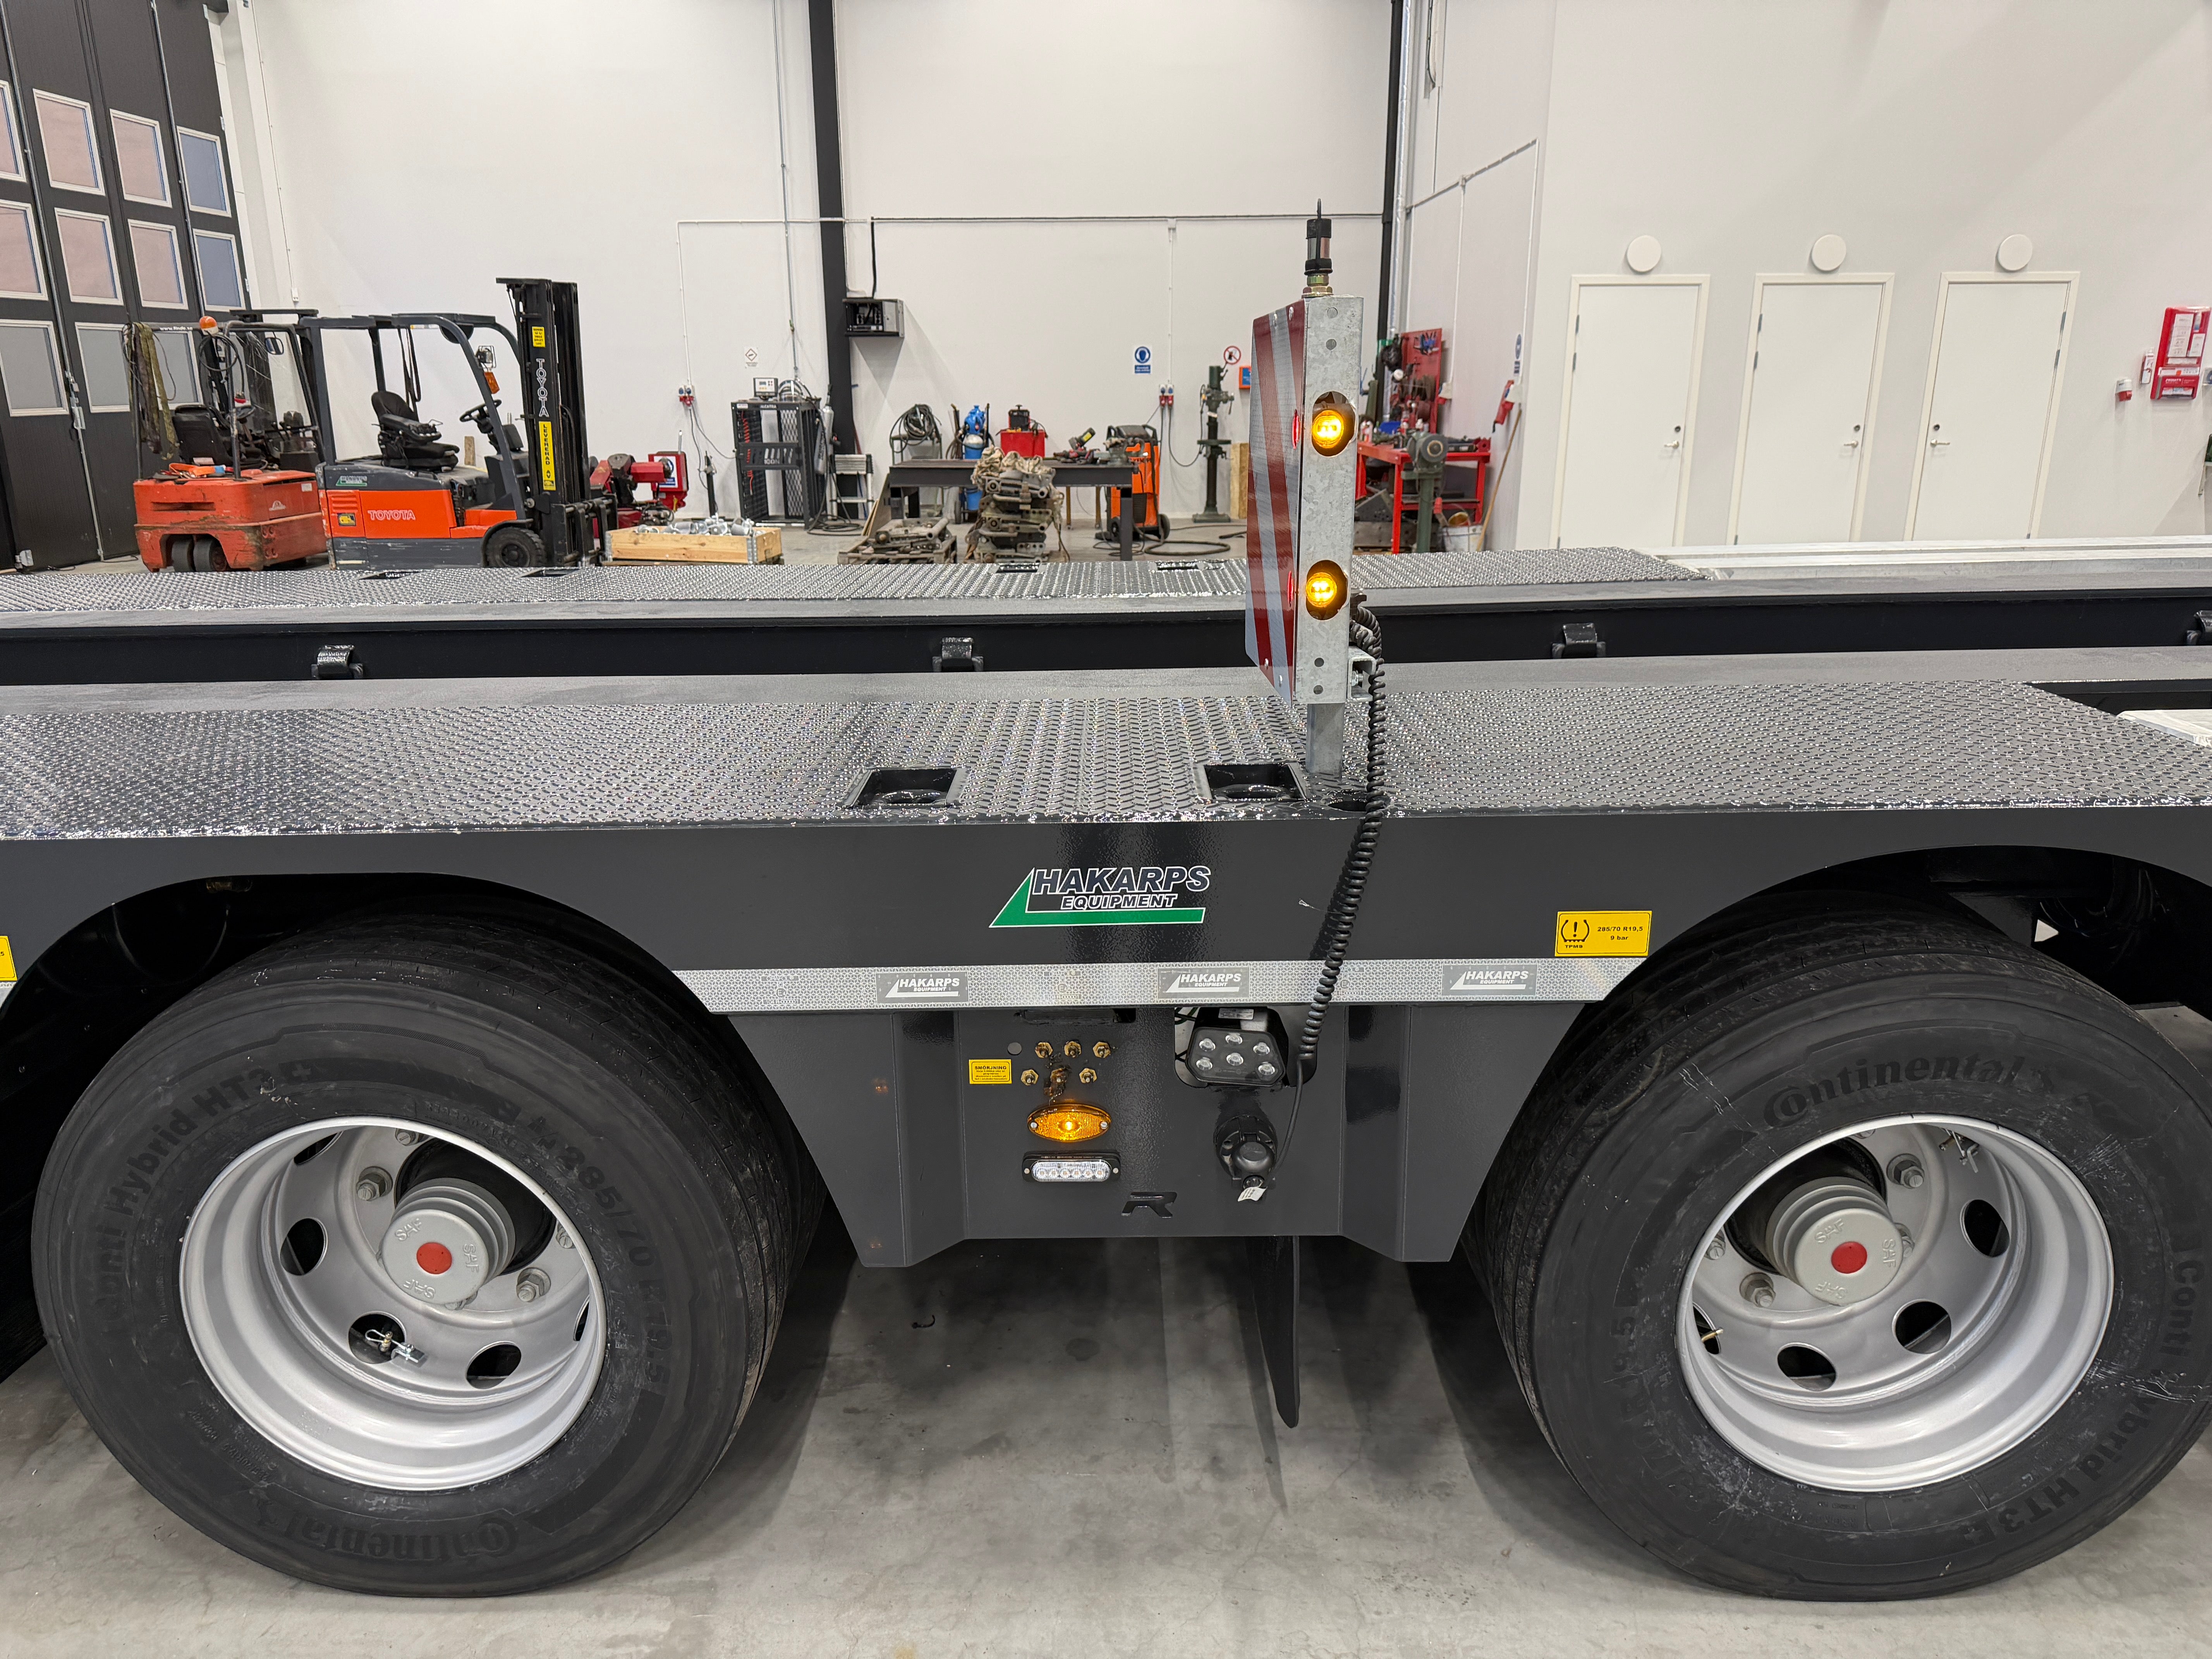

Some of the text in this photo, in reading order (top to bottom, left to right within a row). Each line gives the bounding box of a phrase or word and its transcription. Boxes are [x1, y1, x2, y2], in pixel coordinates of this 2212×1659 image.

[536, 358, 550, 417] TOYOTA
[367, 510, 416, 520] TOYOTA
[1032, 865, 1211, 895] HAKARPS
[1060, 893, 1178, 910] EQUIPMENT
[899, 978, 960, 988] HAKARPS
[1180, 973, 1242, 982] HAKARPS
[1466, 970, 1529, 980] HAKARPS
[1763, 1052, 2025, 1128] Continental
[103, 1108, 198, 1216] Hybrid
[395, 1218, 422, 1241] SAF
[1814, 1218, 1844, 1243] SAF
[463, 1243, 479, 1273] SAF
[1882, 1238, 1896, 1268] SAF
[403, 1279, 436, 1298] SAF
[2159, 1260, 2205, 1357] Conti
[283, 1510, 519, 1561] Continental
